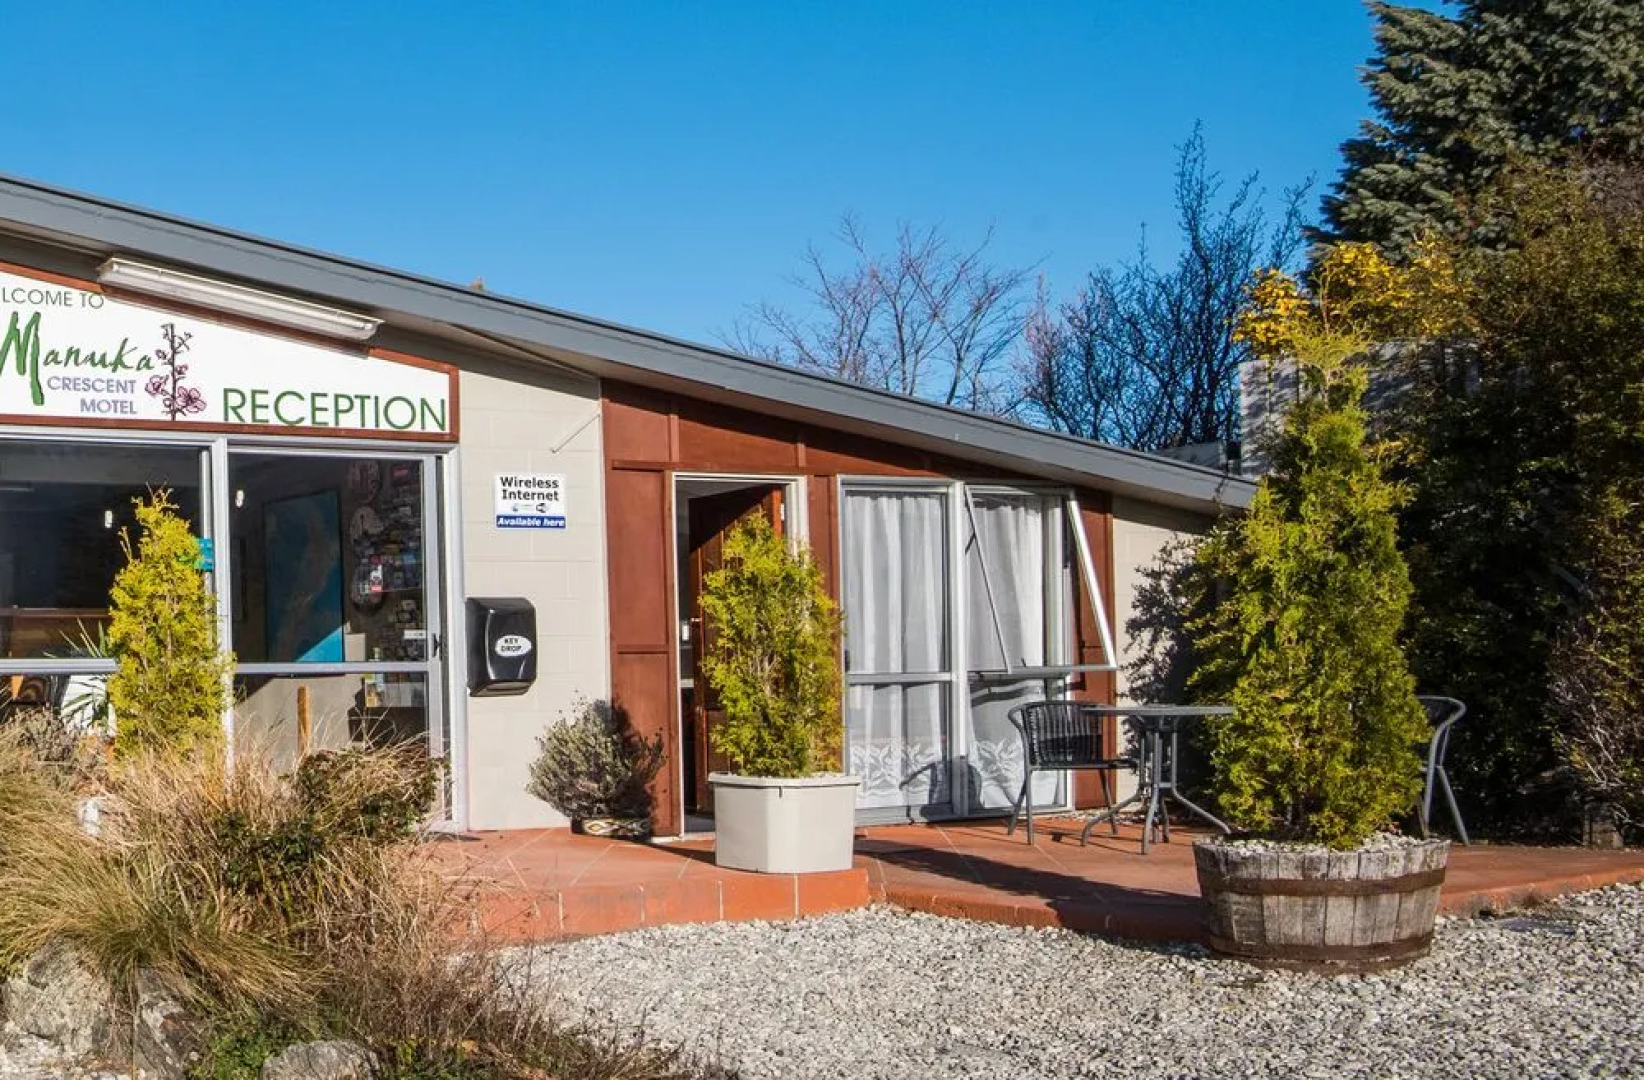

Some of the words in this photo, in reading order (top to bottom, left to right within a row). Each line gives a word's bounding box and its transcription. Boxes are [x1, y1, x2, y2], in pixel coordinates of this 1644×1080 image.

[80, 290, 105, 310] TO
[46, 376, 137, 395] CRESCENT
[79, 398, 138, 415] MOTEL
[222, 386, 447, 432] RECEPTION
[499, 476, 560, 489] Wireless
[501, 489, 560, 502] Internet
[497, 517, 542, 527] Available
[543, 517, 565, 527] here
